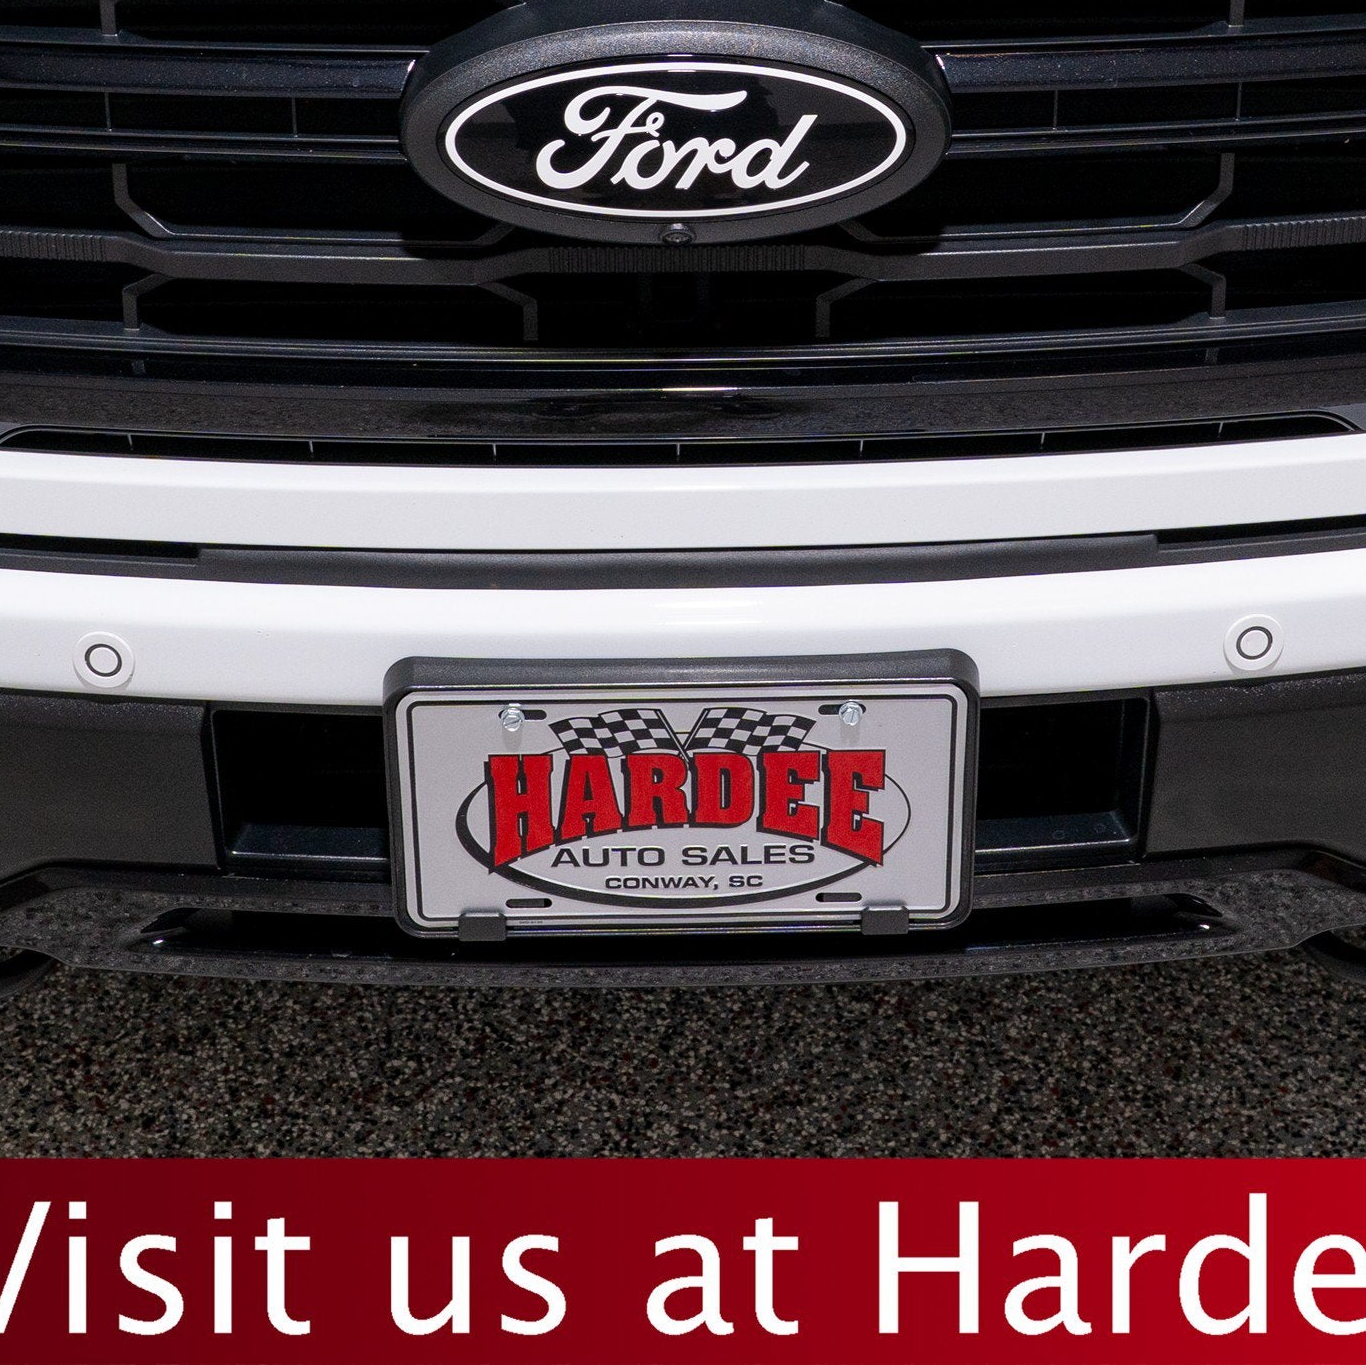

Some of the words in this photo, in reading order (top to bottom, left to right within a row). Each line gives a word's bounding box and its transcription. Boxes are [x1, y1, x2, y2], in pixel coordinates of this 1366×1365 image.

[535, 86, 819, 191] Ford
[488, 750, 886, 874] HARDEE
[551, 846, 666, 868] AUTO
[681, 844, 816, 866] SALES
[604, 875, 719, 891] CONWAY,
[729, 874, 764, 888] SC
